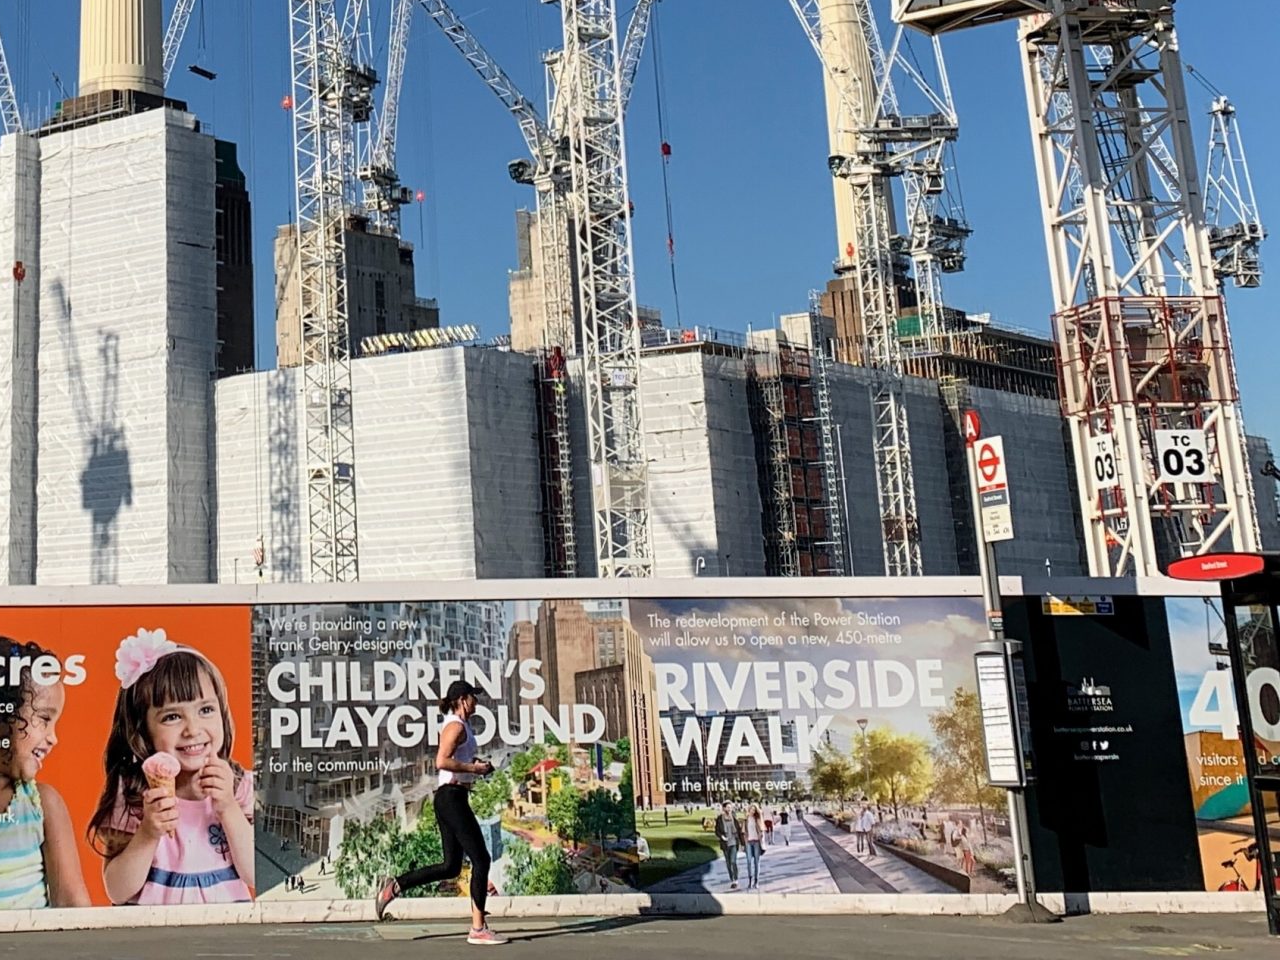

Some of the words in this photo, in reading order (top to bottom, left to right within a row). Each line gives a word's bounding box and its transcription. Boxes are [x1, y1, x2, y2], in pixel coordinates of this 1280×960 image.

[966, 414, 977, 438] A
[1097, 441, 1107, 452] TC
[1171, 435, 1191, 447] TC
[1095, 453, 1115, 482] 03
[1163, 448, 1205, 476] 03
[312, 615, 372, 634] providing
[377, 620, 386, 631] a
[391, 620, 418, 631] new
[647, 613, 670, 628] The
[675, 612, 768, 631] redevelopment
[773, 611, 787, 627] of
[790, 612, 810, 627] the
[814, 612, 852, 626] Power
[856, 611, 901, 626] Station
[268, 636, 304, 652] Frank
[308, 635, 413, 654] Gehry-designed
[649, 632, 670, 647] will
[675, 632, 710, 647] allow
[715, 636, 729, 646] us
[733, 633, 746, 646] to
[750, 634, 783, 649] open
[787, 635, 797, 646] a
[802, 633, 830, 647] new,
[836, 630, 902, 645] 450-metre
[655, 658, 946, 712] RIVERSIDE
[659, 715, 835, 766] WALK
[269, 756, 288, 773] for
[292, 756, 313, 772] the
[1196, 752, 1238, 766] visitors
[659, 776, 677, 792] for
[682, 776, 701, 792] the
[706, 776, 729, 791] first
[733, 777, 761, 791] time
[765, 779, 796, 791] ever.
[1200, 773, 1232, 786] since
[1236, 772, 1244, 786] it
